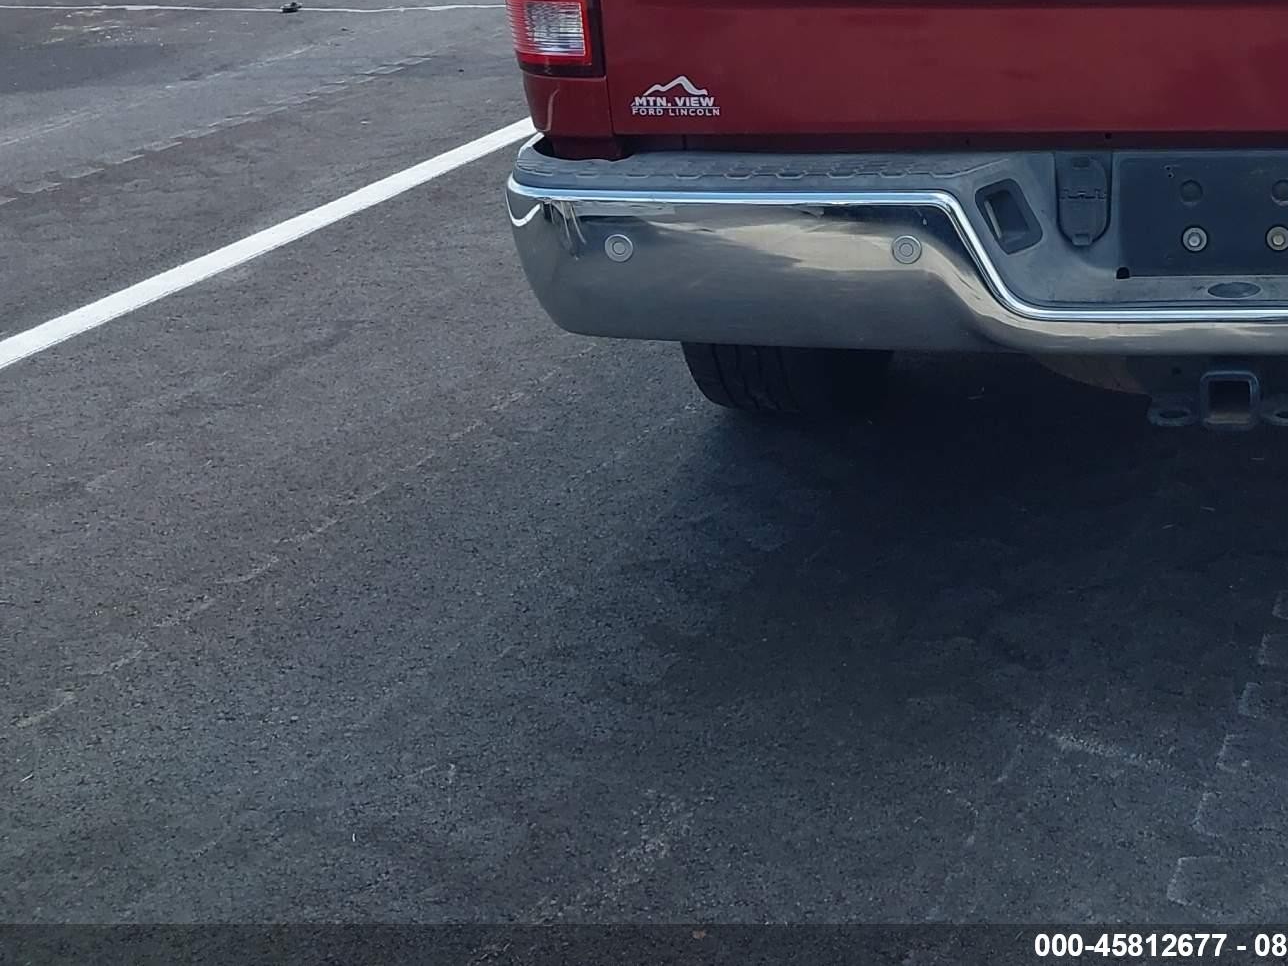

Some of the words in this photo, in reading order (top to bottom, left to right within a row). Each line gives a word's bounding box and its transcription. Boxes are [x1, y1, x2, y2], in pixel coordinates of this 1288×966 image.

[634, 96, 672, 107] MTN.
[674, 96, 715, 107] VIEW
[632, 108, 664, 116] FORD
[668, 108, 721, 116] LINCOLN
